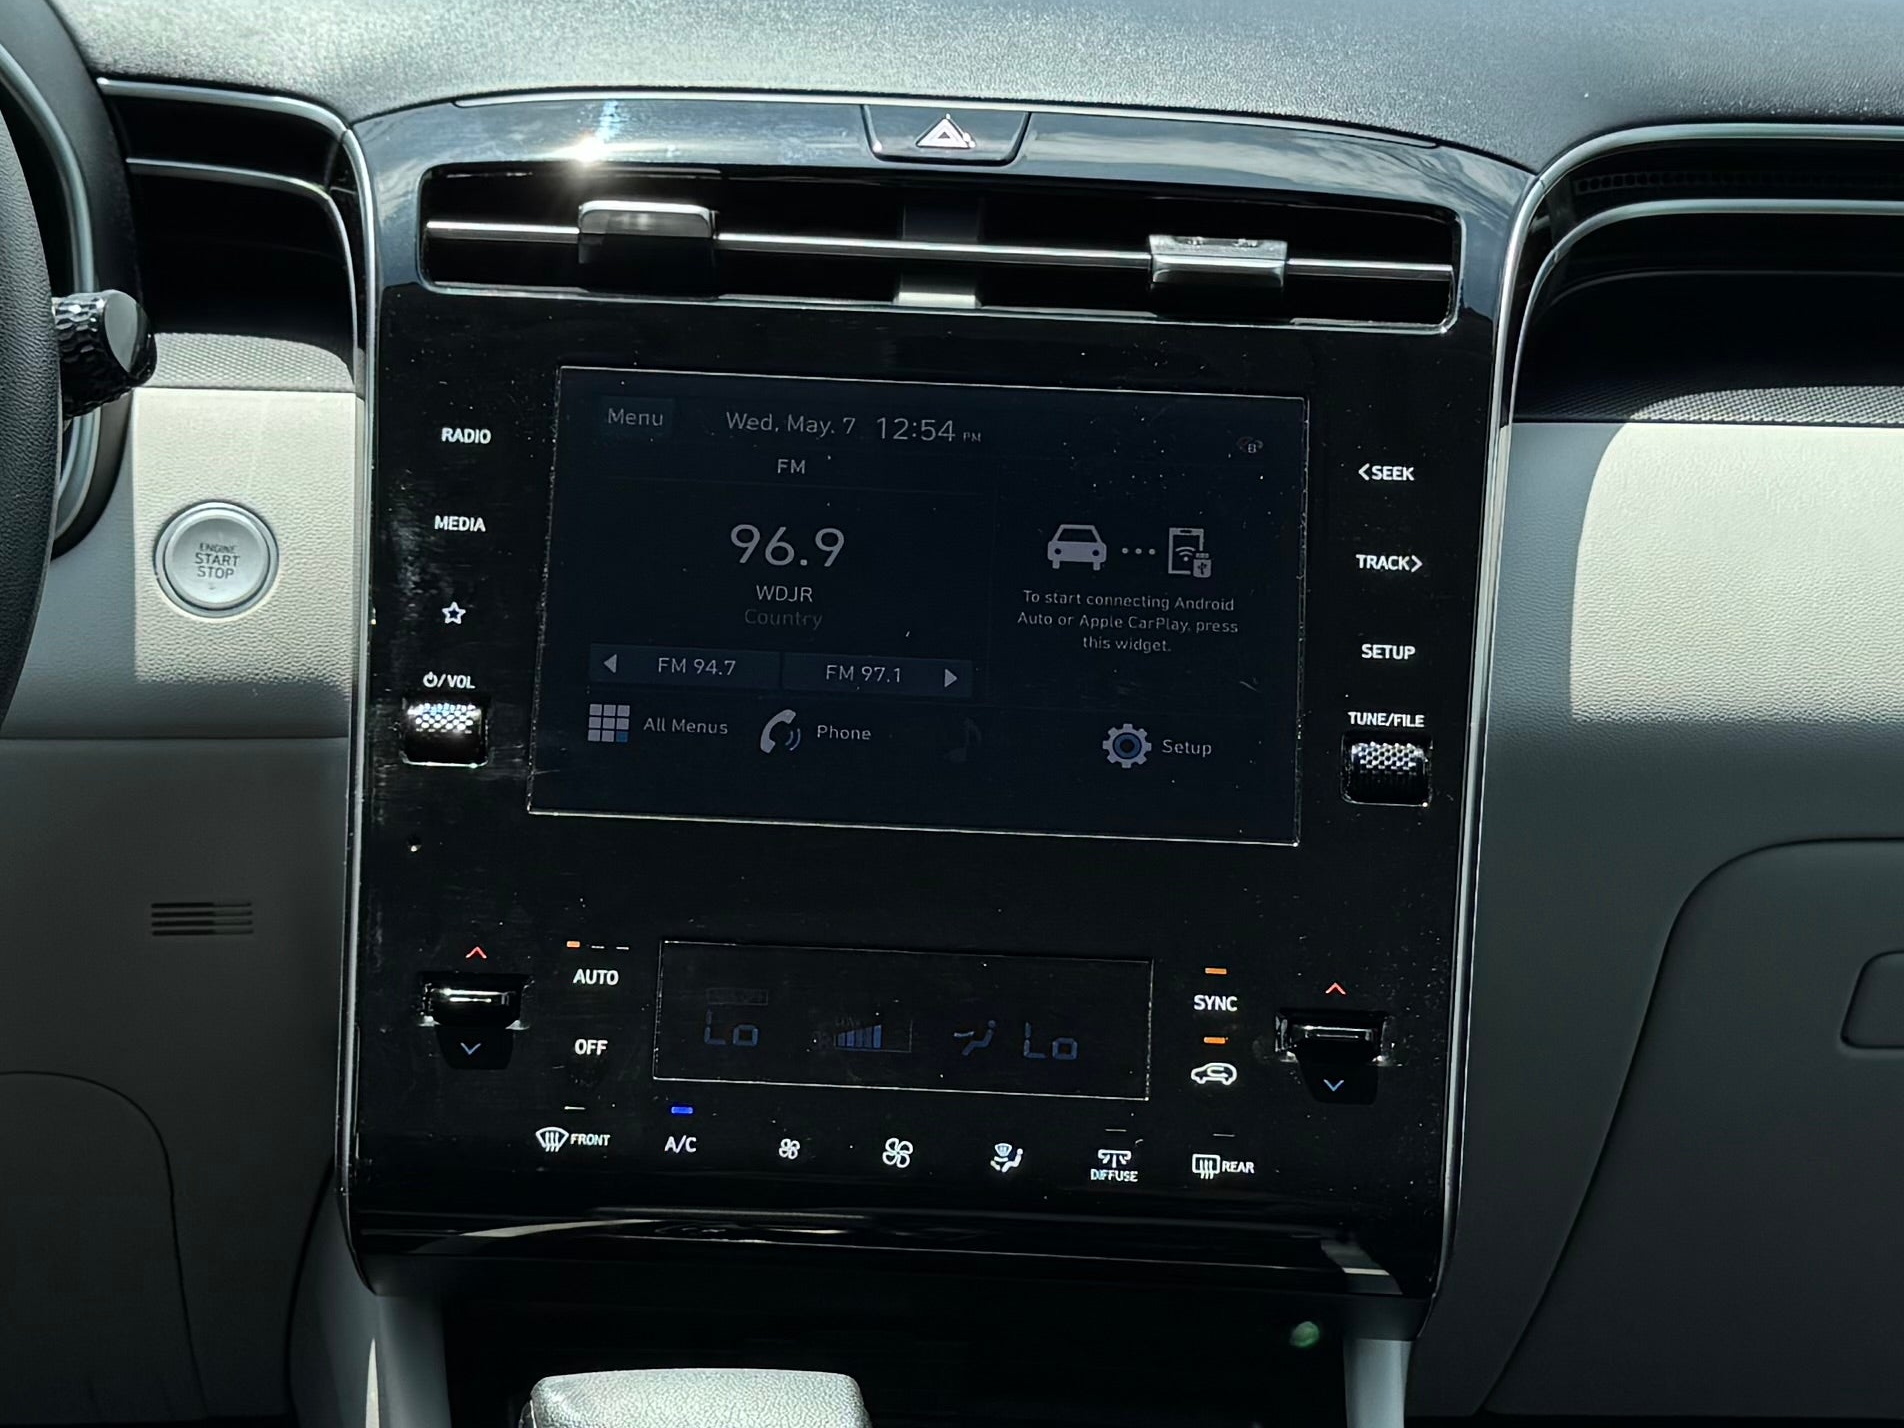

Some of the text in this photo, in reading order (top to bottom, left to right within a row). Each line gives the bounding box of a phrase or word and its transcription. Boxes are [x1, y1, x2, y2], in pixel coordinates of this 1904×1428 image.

[607, 408, 664, 426] Menu
[441, 428, 492, 444] RADIO
[787, 415, 835, 436] May.
[843, 417, 856, 435] 7
[876, 417, 956, 442] 12:54
[963, 431, 982, 443] PM
[777, 459, 806, 475] FM
[1371, 465, 1415, 482] SEEK
[434, 515, 486, 533] MEDIA
[199, 543, 236, 553] ENGINE
[729, 523, 845, 568] 96.9
[195, 553, 240, 566] START
[1356, 555, 1411, 571] TRACK
[197, 566, 234, 579] STOP
[755, 584, 813, 604] WDJR
[1023, 589, 1235, 612] To start connecting Android
[743, 608, 823, 630] Country
[1017, 612, 1053, 627] Auto
[1057, 615, 1075, 628] or
[1079, 614, 1124, 633] Apple
[1196, 619, 1239, 636] press
[1083, 635, 1172, 654] this widget.
[1361, 644, 1416, 661] SETUP
[658, 657, 737, 676] FM 94.7
[825, 664, 902, 683] FM 97.1
[644, 717, 729, 736] All Menus
[1348, 712, 1425, 729] TUNE/FILE
[817, 724, 871, 742] Phone
[1161, 739, 1213, 758] Setup
[573, 969, 619, 986] AUTO
[1194, 995, 1238, 1012] SYNC
[574, 1039, 608, 1056] OFF
[571, 1133, 610, 1147] FRONT
[665, 1135, 697, 1154] A/C
[1091, 1168, 1138, 1183] DIFFUSE
[1222, 1160, 1255, 1174] REAR
